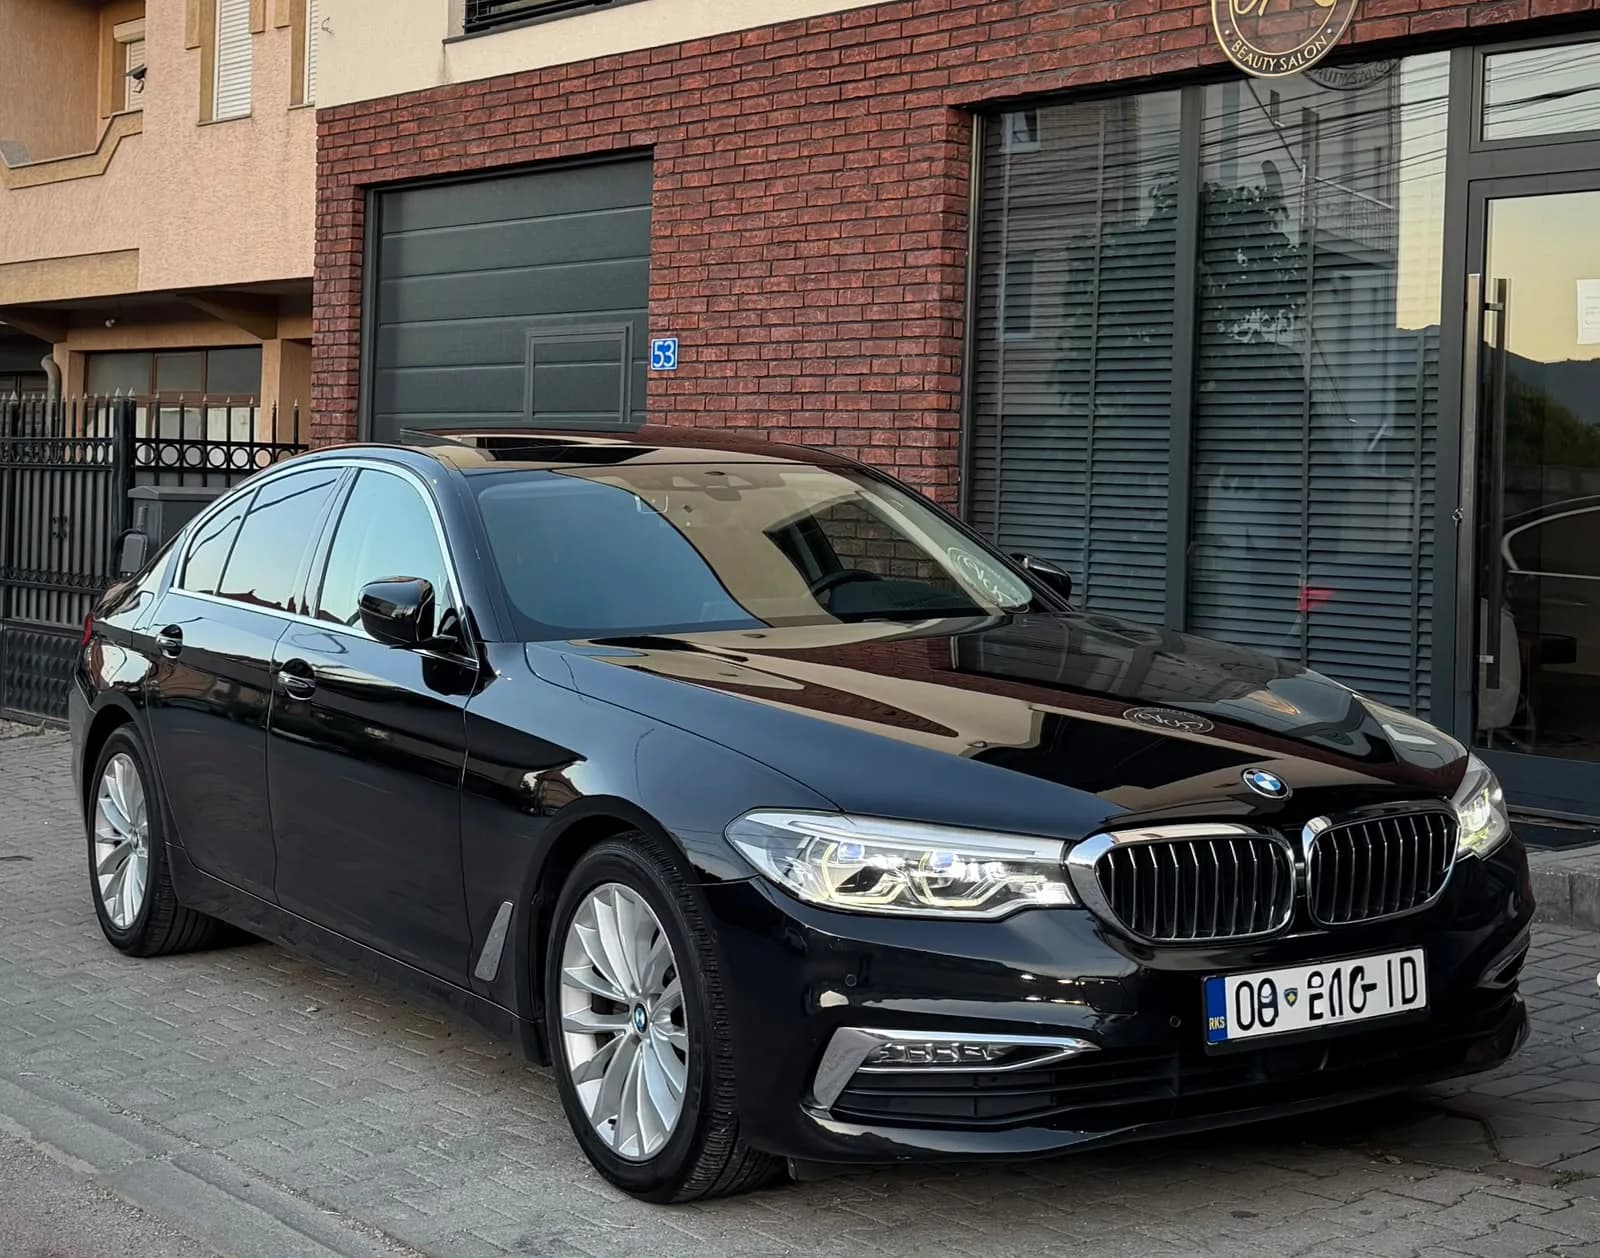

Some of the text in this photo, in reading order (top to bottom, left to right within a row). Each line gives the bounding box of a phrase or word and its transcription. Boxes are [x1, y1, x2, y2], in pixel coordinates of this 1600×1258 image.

[1231, 35, 1328, 71] BEAUTY SALON
[653, 340, 675, 368] 53
[1208, 1017, 1225, 1031] RKS
